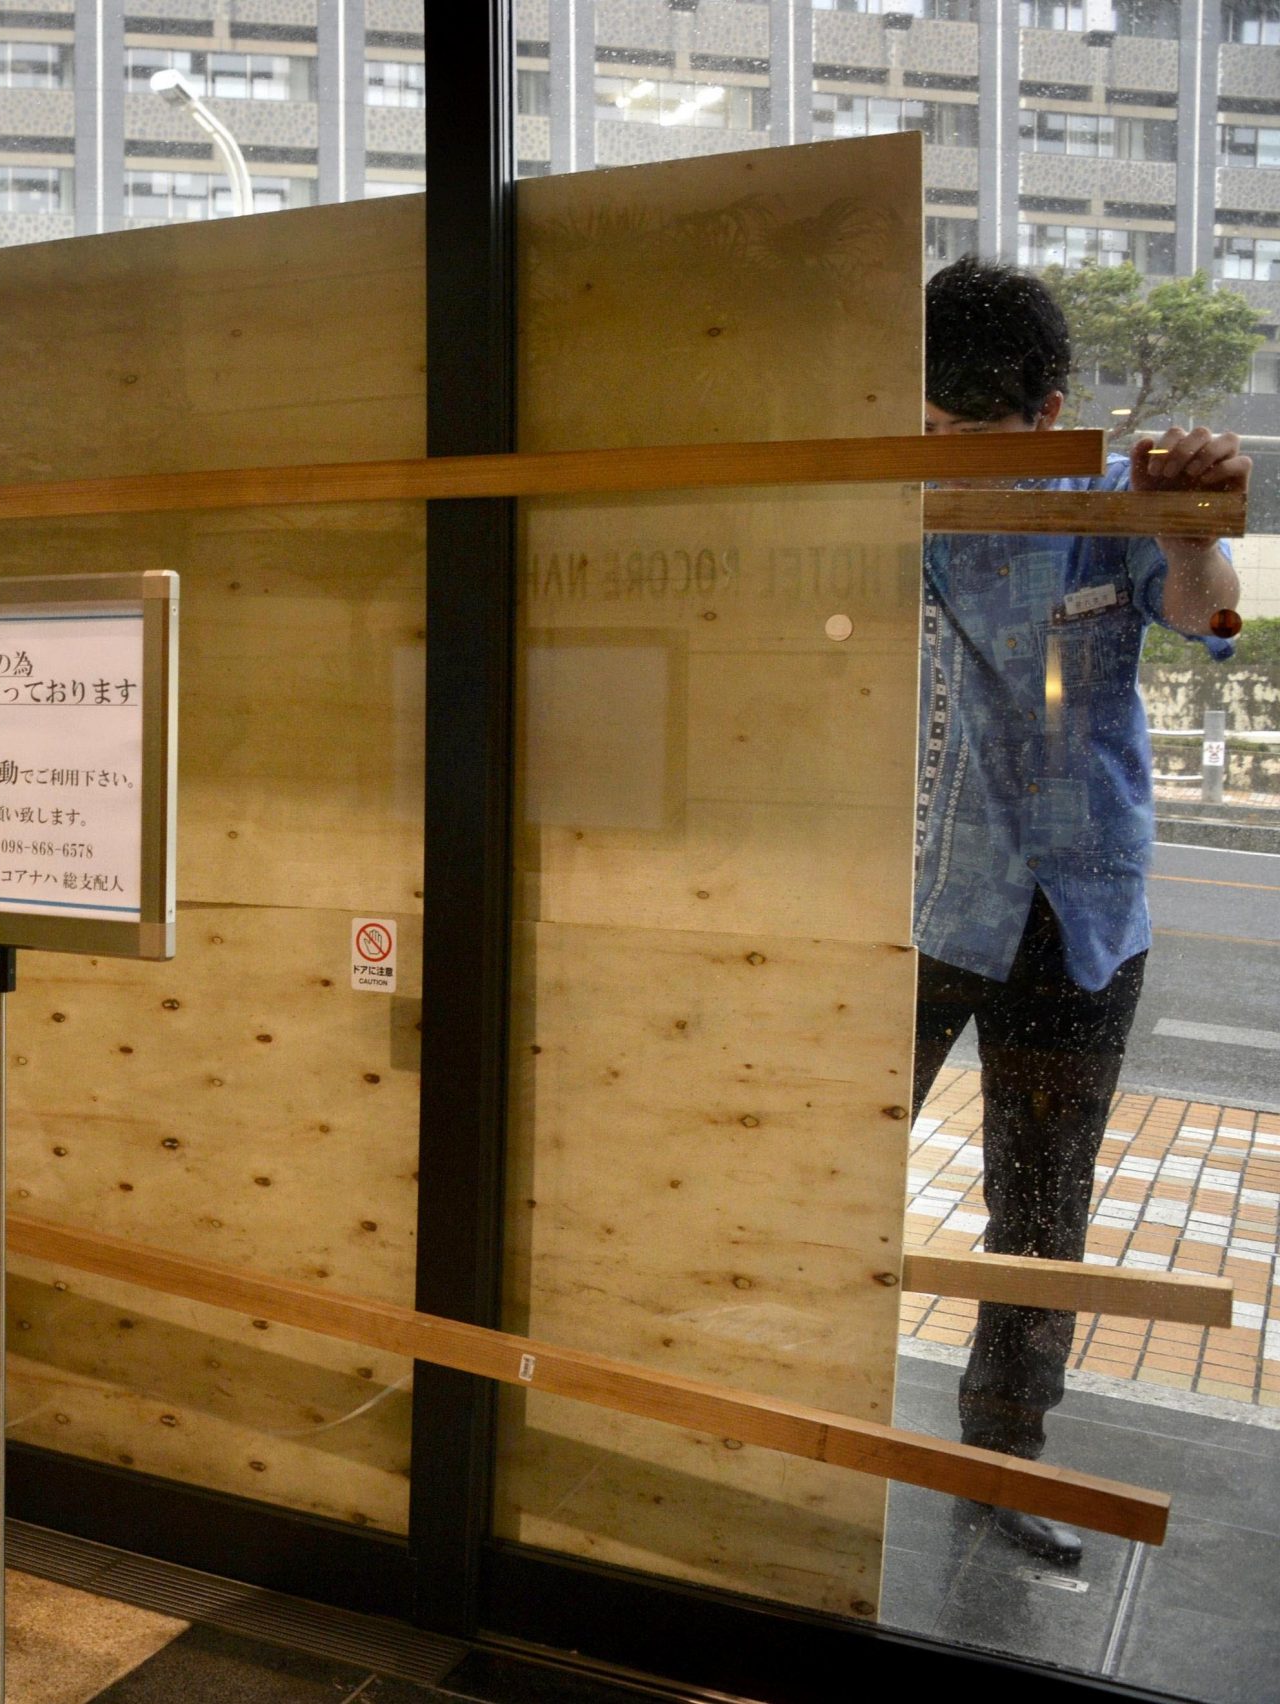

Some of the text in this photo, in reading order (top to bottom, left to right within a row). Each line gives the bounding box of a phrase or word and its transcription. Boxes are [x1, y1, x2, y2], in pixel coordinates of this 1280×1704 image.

[1, 839, 94, 860] 098-868-6578
[63, 871, 125, 893] 総支配人
[353, 965, 393, 977] ドアに注意
[359, 978, 388, 986] CAUTION
